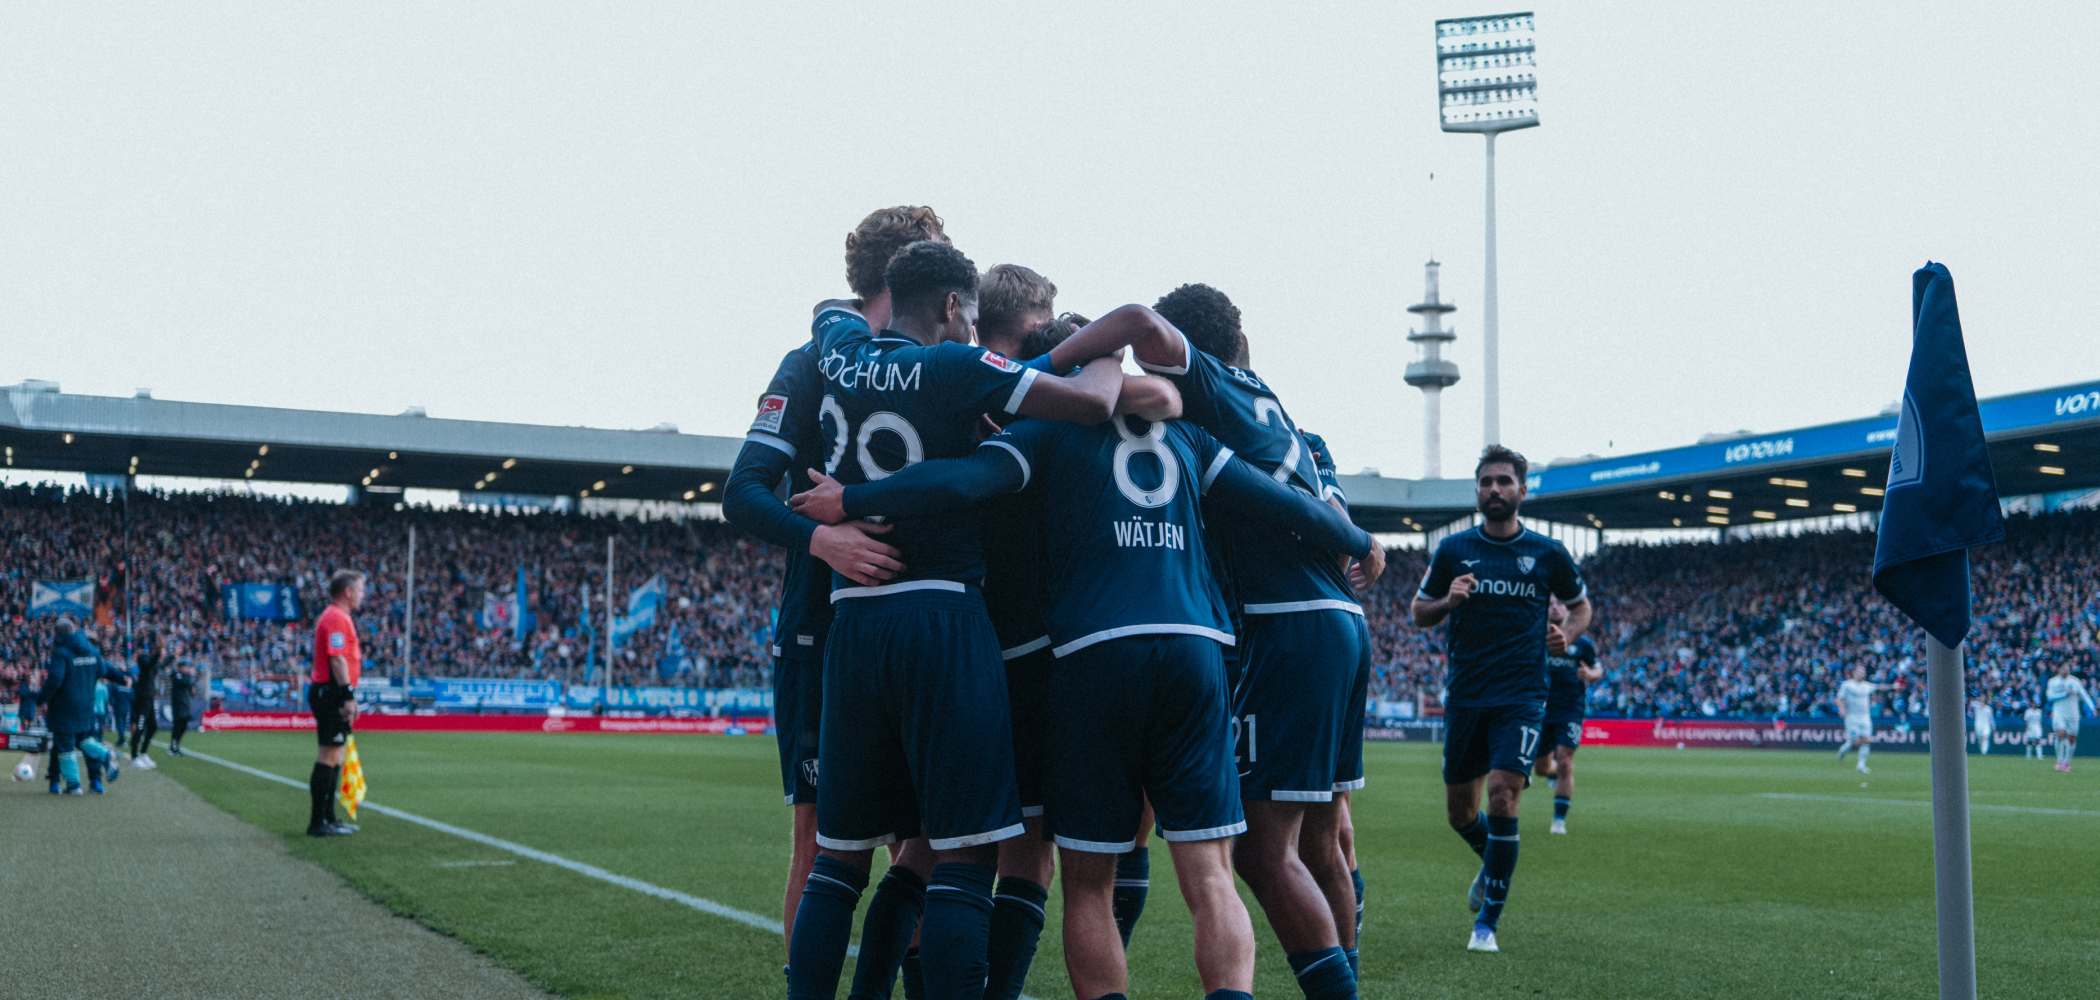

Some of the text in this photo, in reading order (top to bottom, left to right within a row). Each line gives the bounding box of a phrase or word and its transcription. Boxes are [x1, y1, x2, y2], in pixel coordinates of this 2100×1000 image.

[818, 349, 921, 391] BOCHUM
[2055, 391, 2100, 415] VON
[1112, 413, 1180, 508] 8
[1114, 516, 1185, 550] WÄTJEN
[1469, 578, 1536, 598] ONOVIA
[1231, 714, 1257, 763] 21
[1520, 725, 1539, 757] 17
